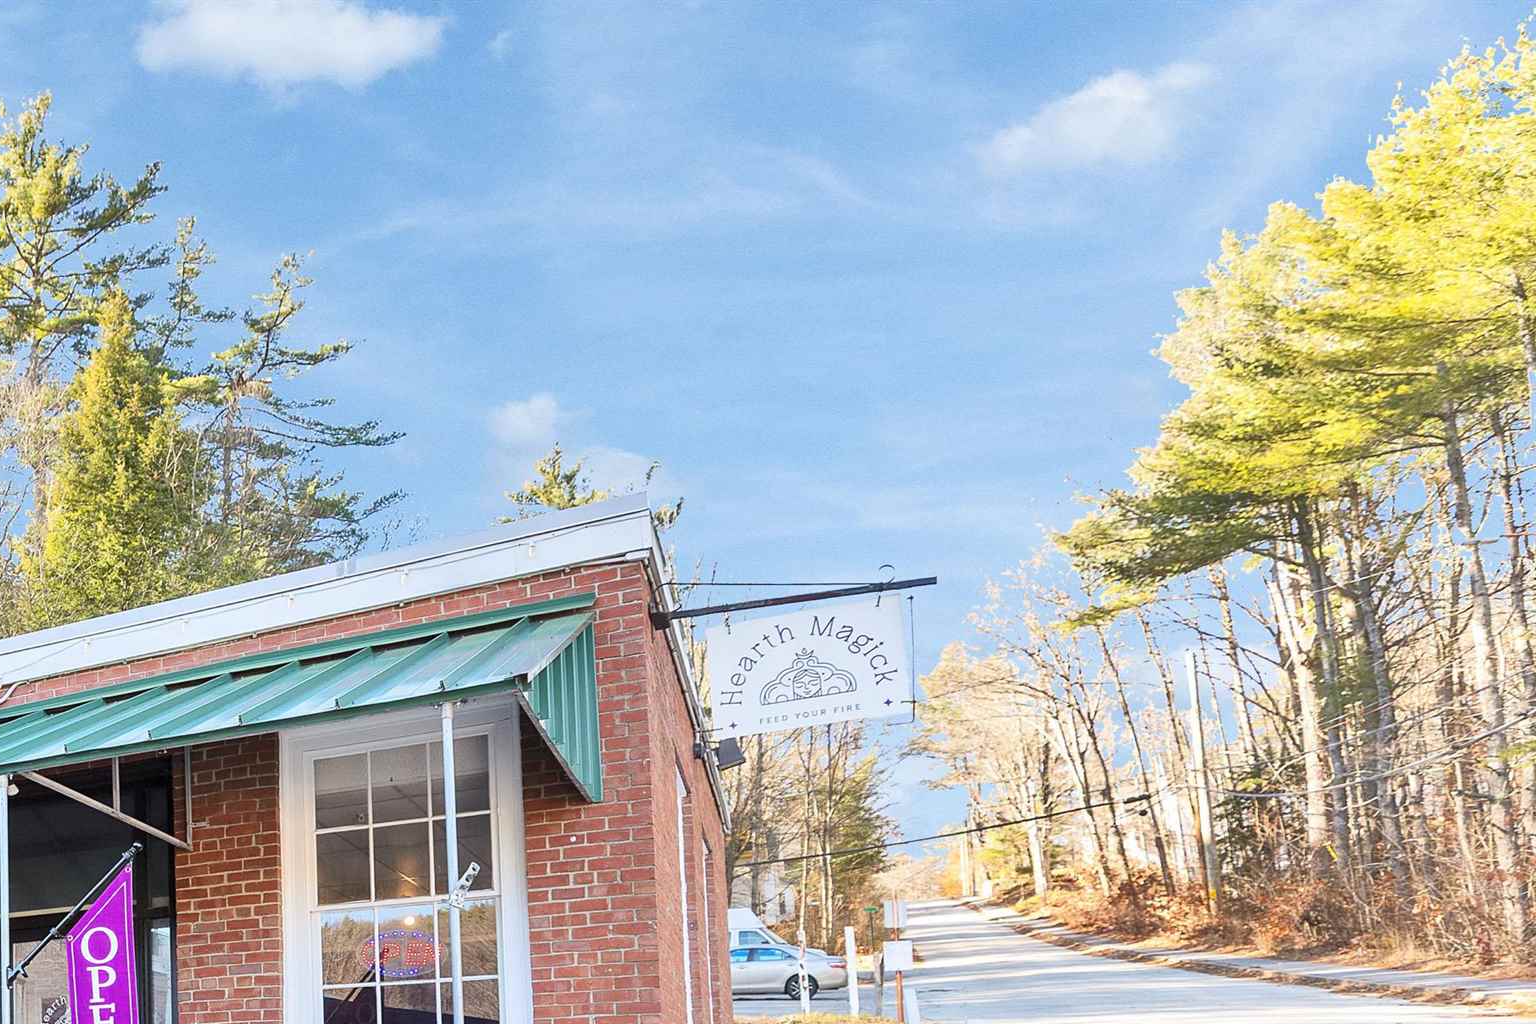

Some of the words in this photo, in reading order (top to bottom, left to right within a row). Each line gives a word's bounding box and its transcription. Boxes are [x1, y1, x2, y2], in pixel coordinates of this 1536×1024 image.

[720, 623, 795, 706] Hearth
[810, 615, 898, 686] Magick
[759, 714, 788, 725] FEED
[795, 709, 827, 720] YOUR
[833, 703, 861, 714] FIRE
[360, 942, 446, 966] OPEN
